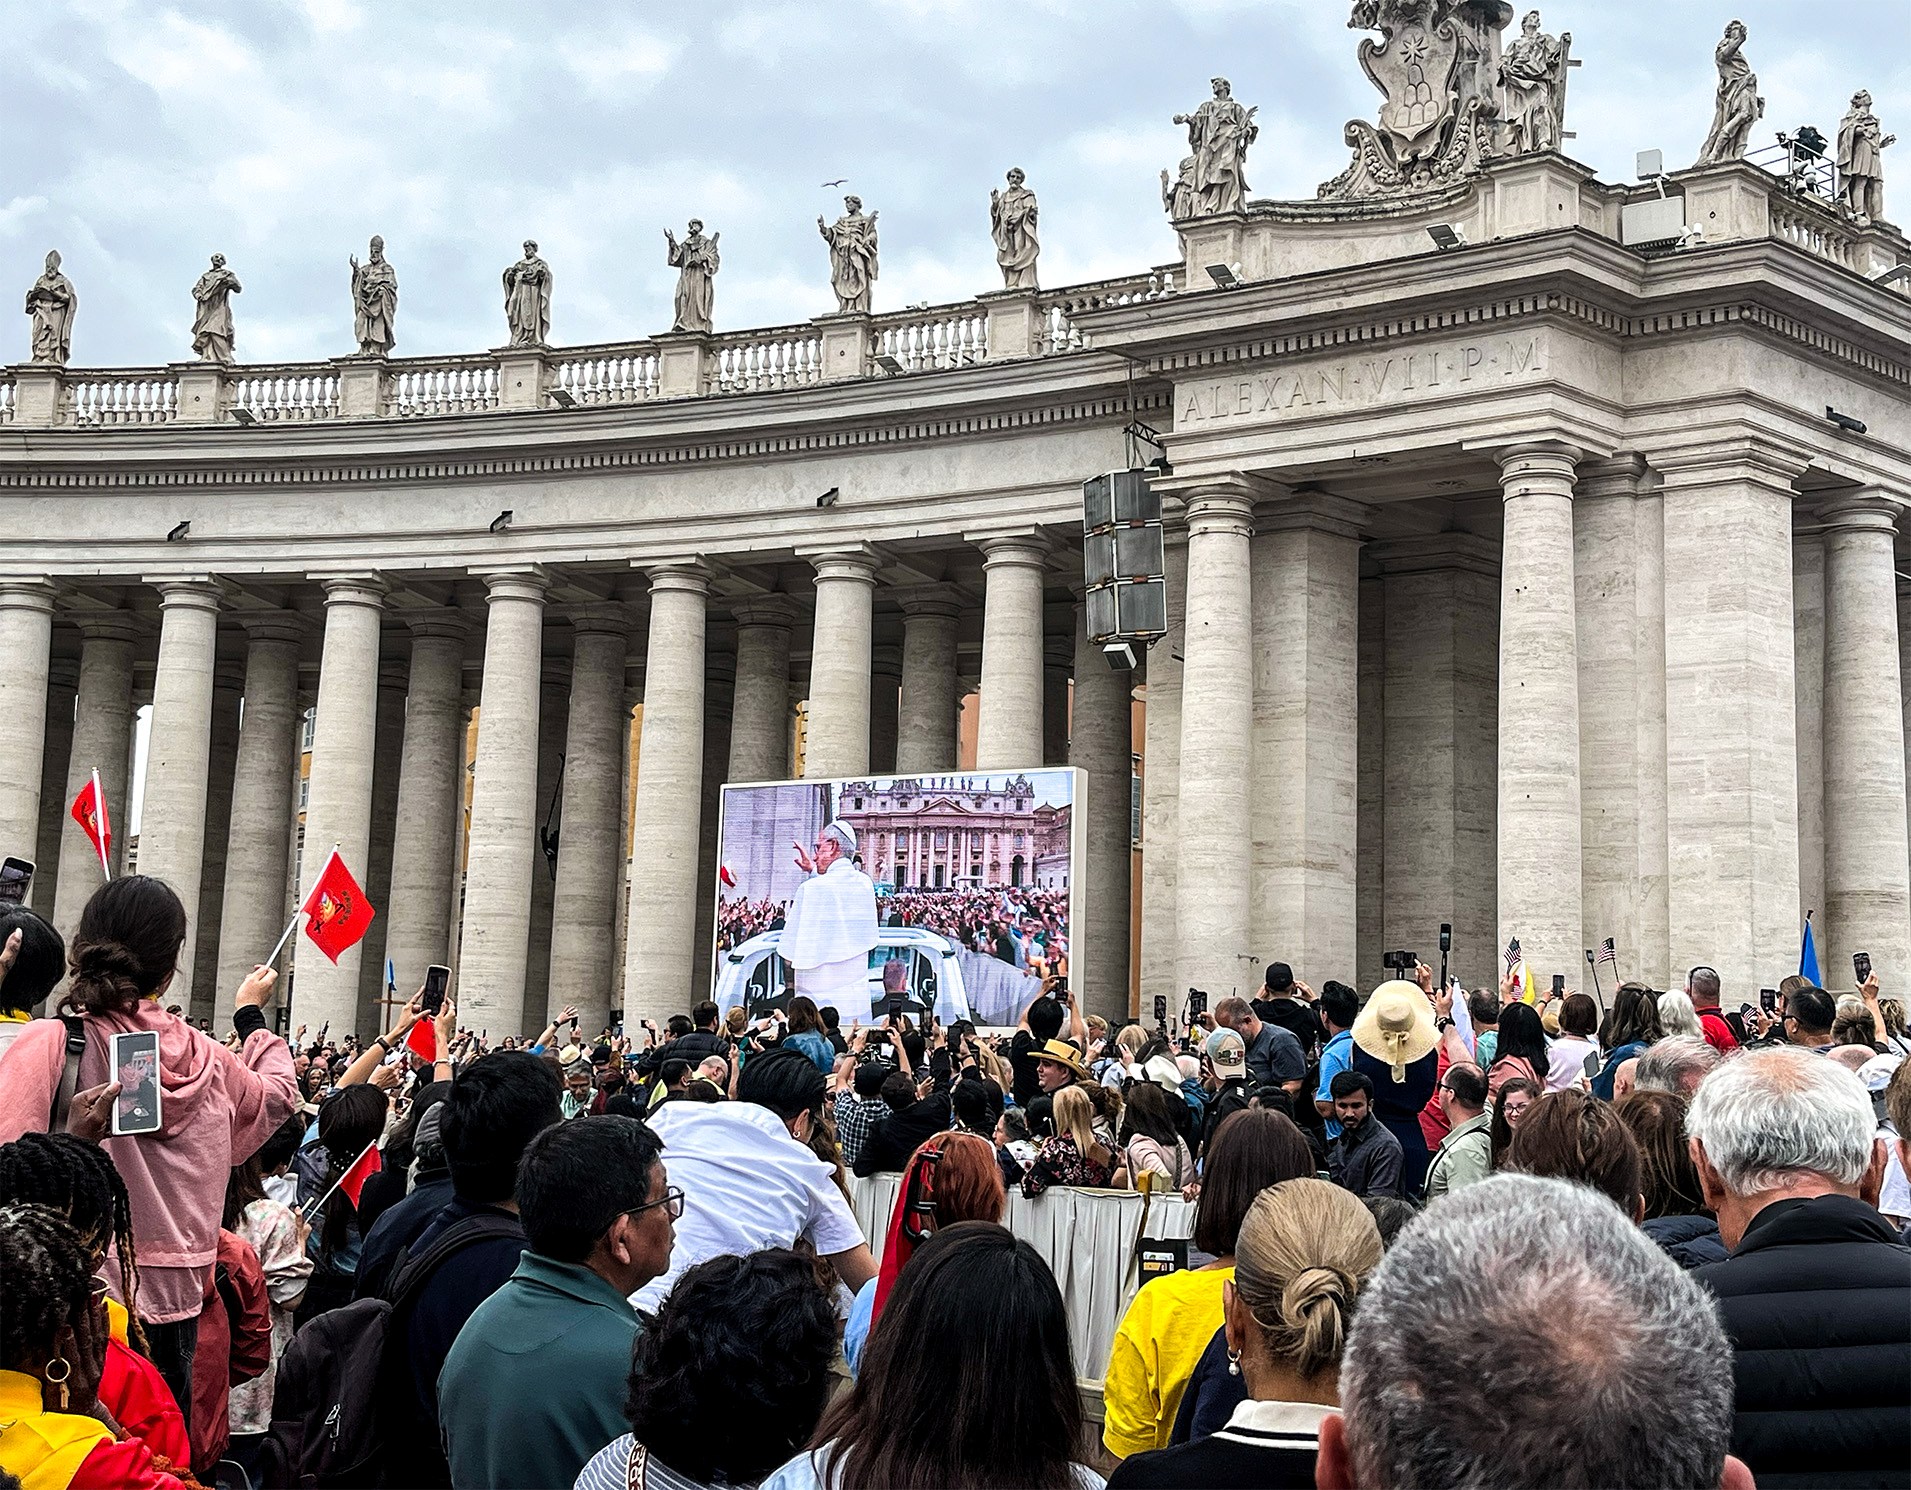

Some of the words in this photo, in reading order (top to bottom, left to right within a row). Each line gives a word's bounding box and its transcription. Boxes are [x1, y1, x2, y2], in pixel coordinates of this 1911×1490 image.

[1180, 367, 1345, 422] ALEXAN
[1364, 353, 1440, 395] VII
[1459, 347, 1483, 382] P
[1504, 337, 1542, 375] M
